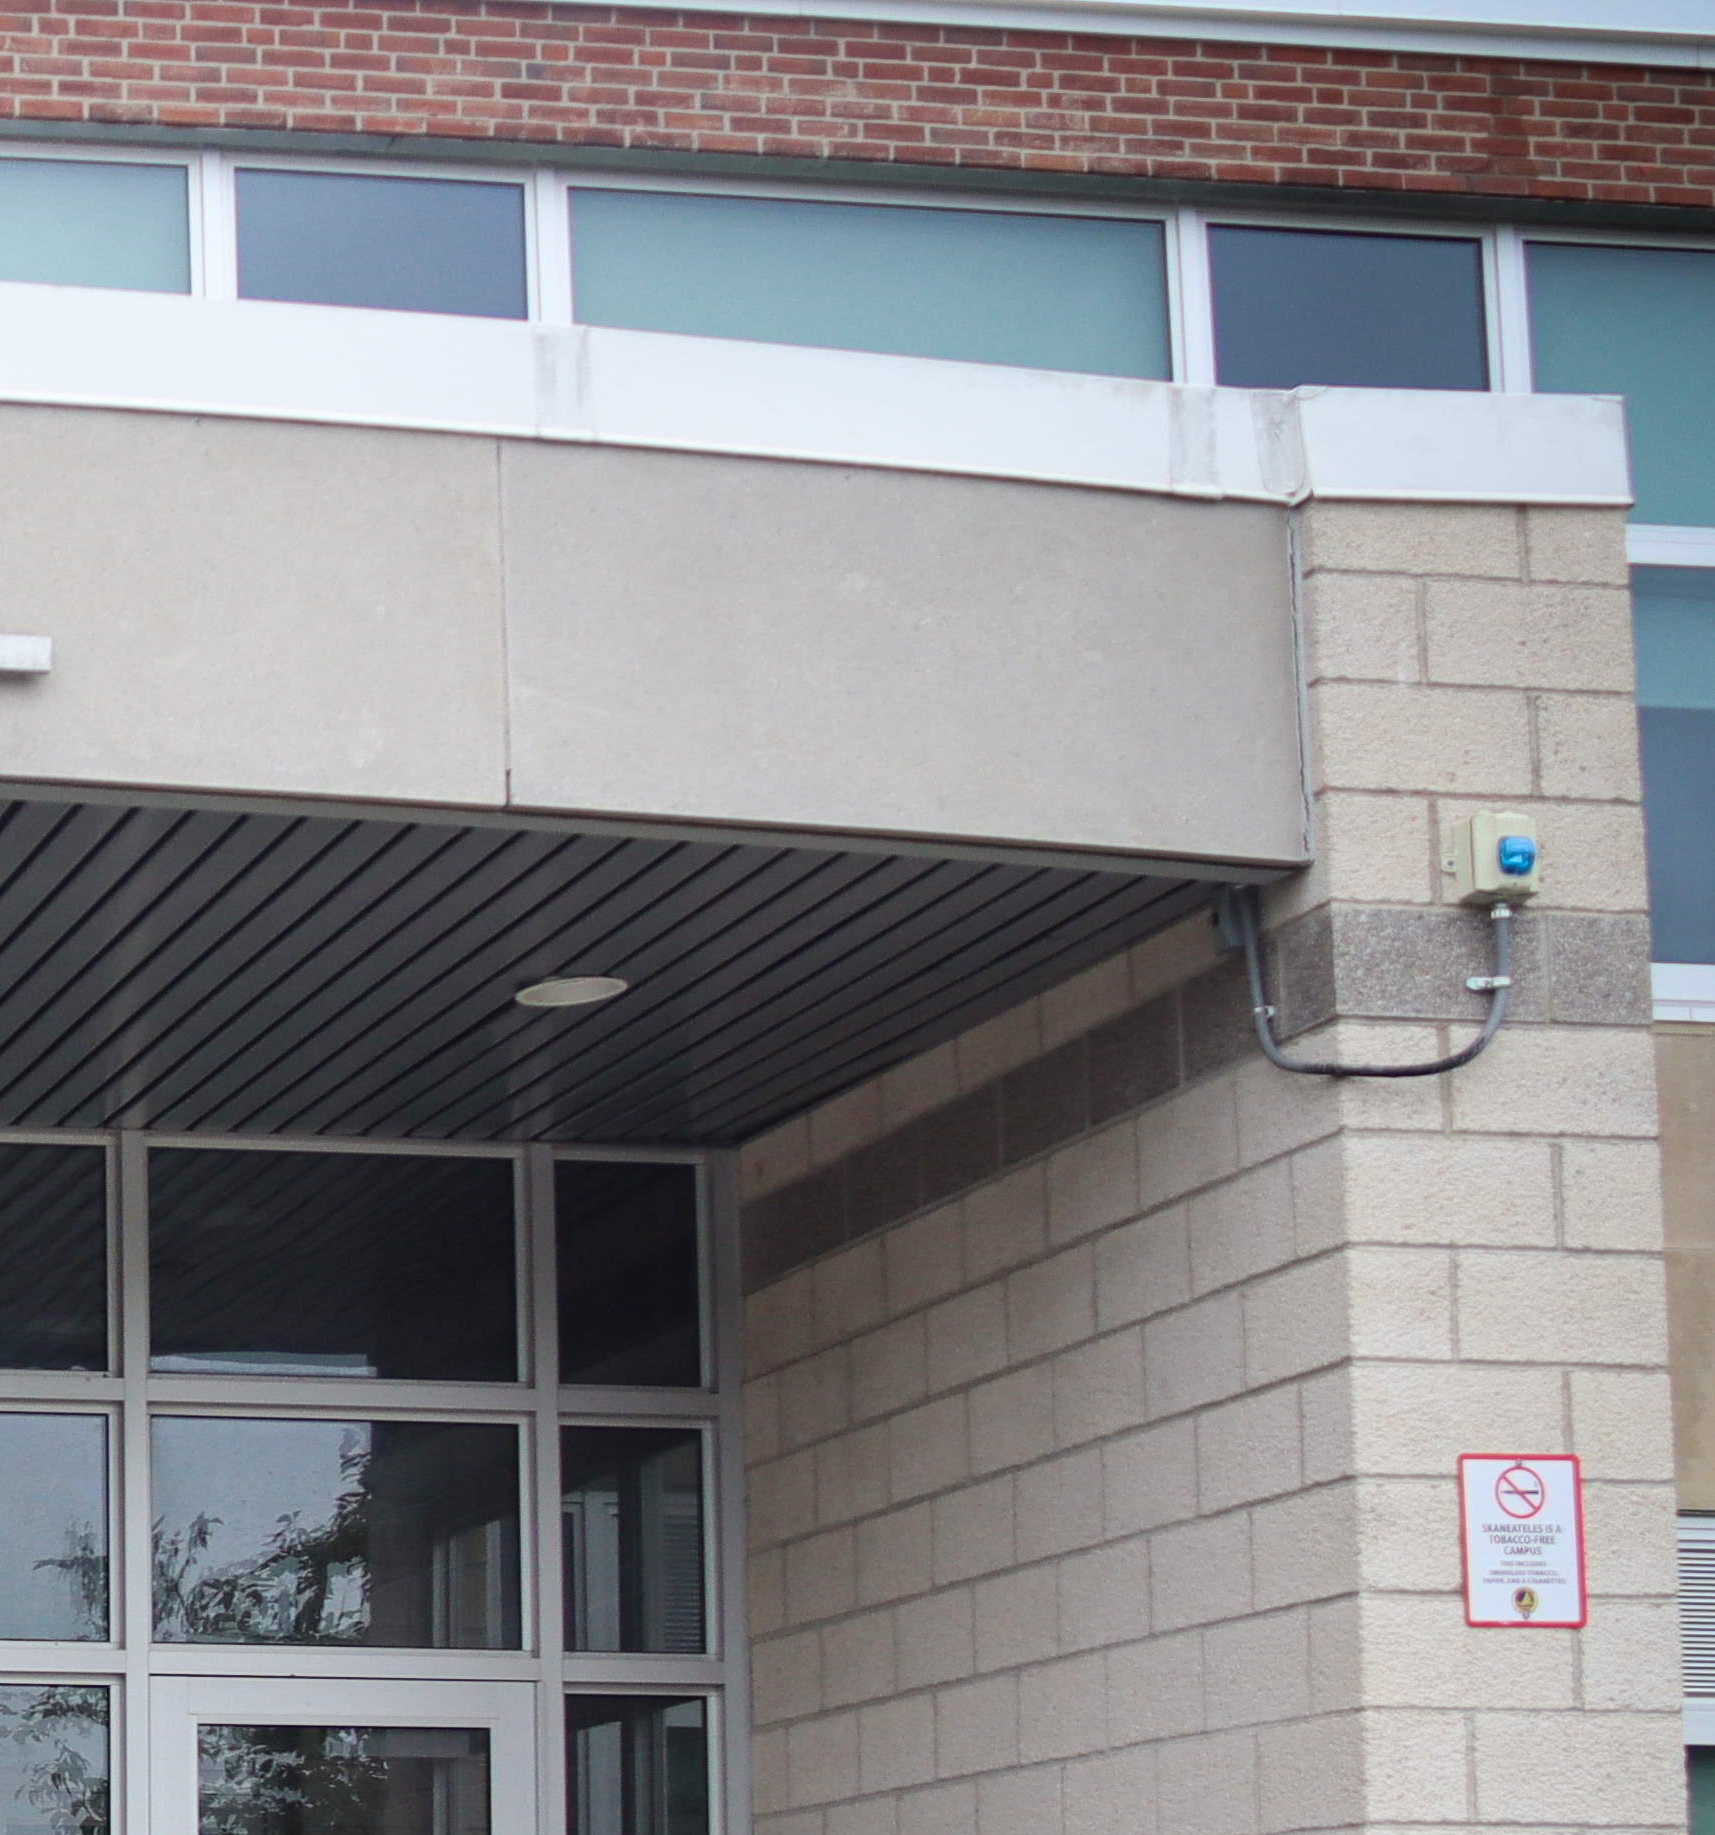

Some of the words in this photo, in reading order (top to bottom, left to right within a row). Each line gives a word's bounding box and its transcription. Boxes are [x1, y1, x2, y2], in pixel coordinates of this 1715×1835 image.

[1482, 1523, 1543, 1533] SKANEATELES
[1545, 1523, 1553, 1533] IS
[1555, 1524, 1562, 1533] A
[1489, 1534, 1556, 1544] TOBACCO-FREE
[1503, 1545, 1542, 1555] CAMPUS
